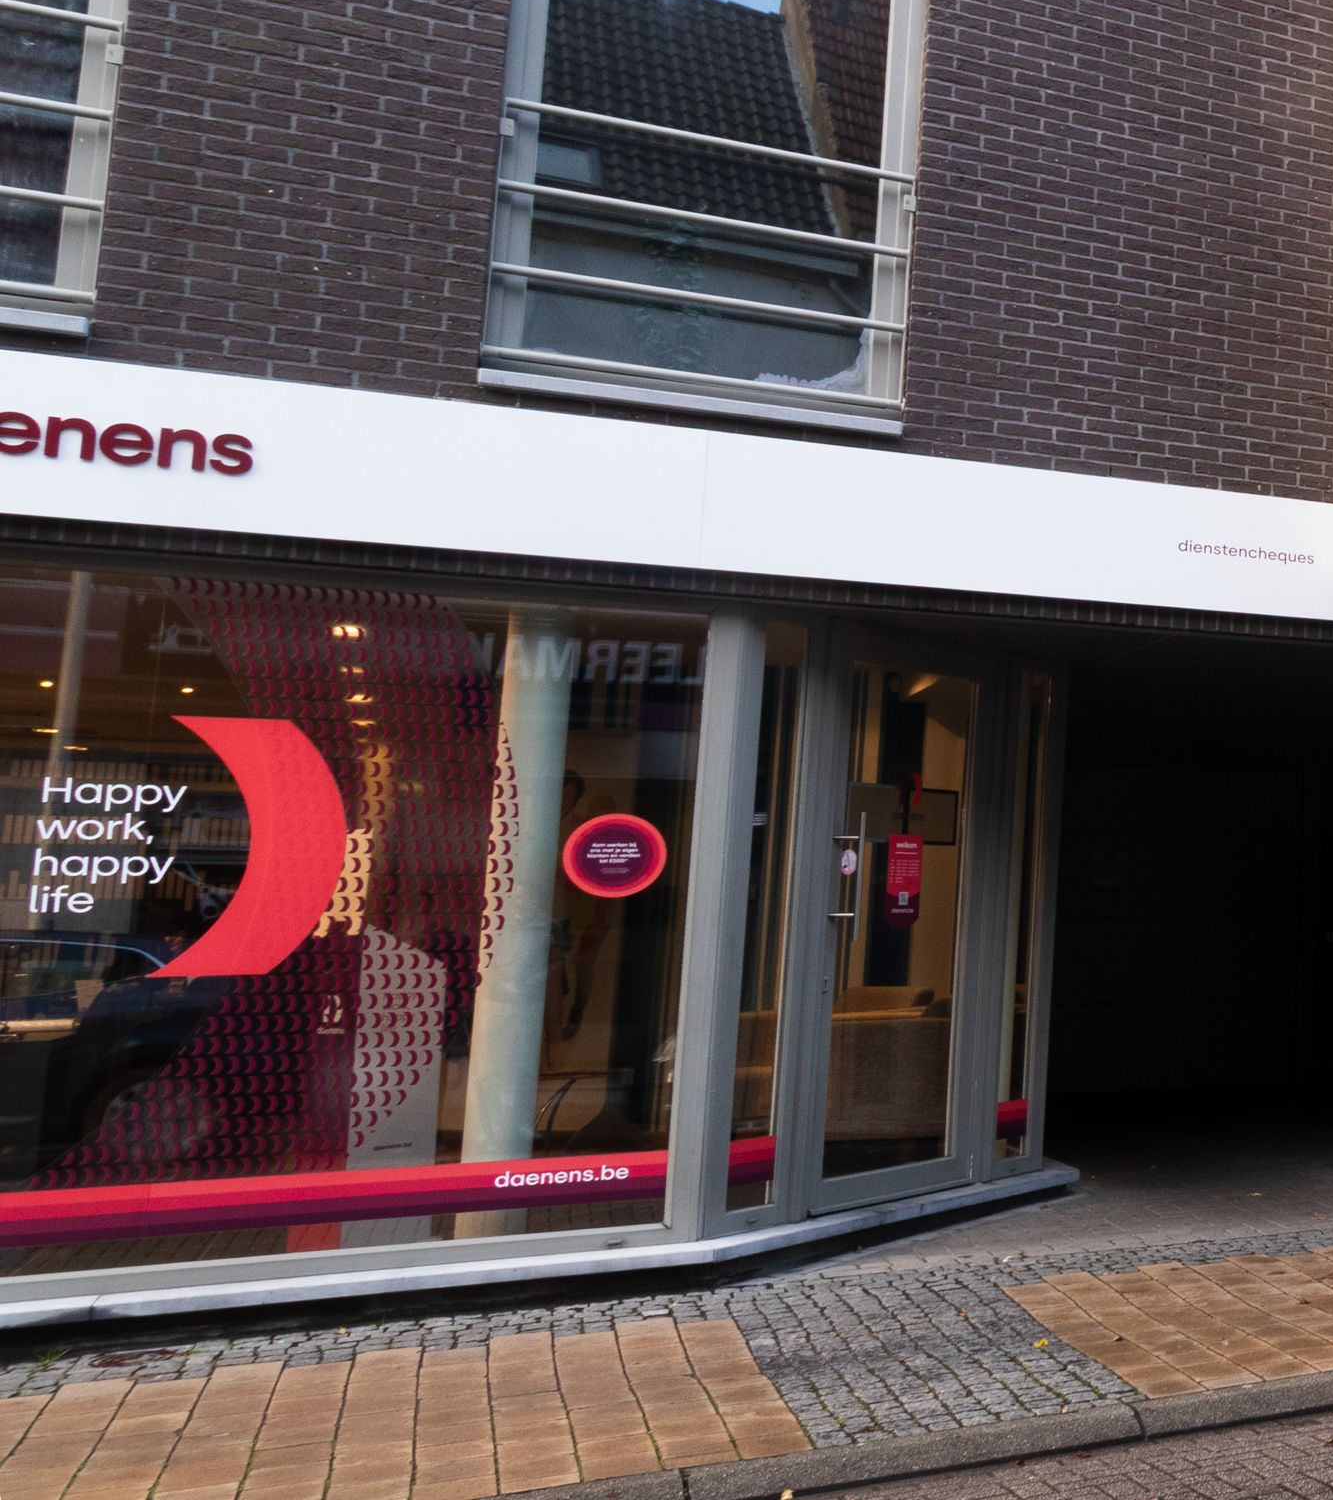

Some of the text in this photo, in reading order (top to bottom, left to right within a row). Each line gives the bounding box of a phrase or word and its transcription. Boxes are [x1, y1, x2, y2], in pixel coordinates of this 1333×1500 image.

[1178, 539, 1315, 565] dienstencheques
[41, 776, 188, 813] Happy
[36, 812, 154, 845] work,
[32, 848, 176, 884] happy
[28, 884, 95, 913] life
[494, 1164, 630, 1189] daenens.be
